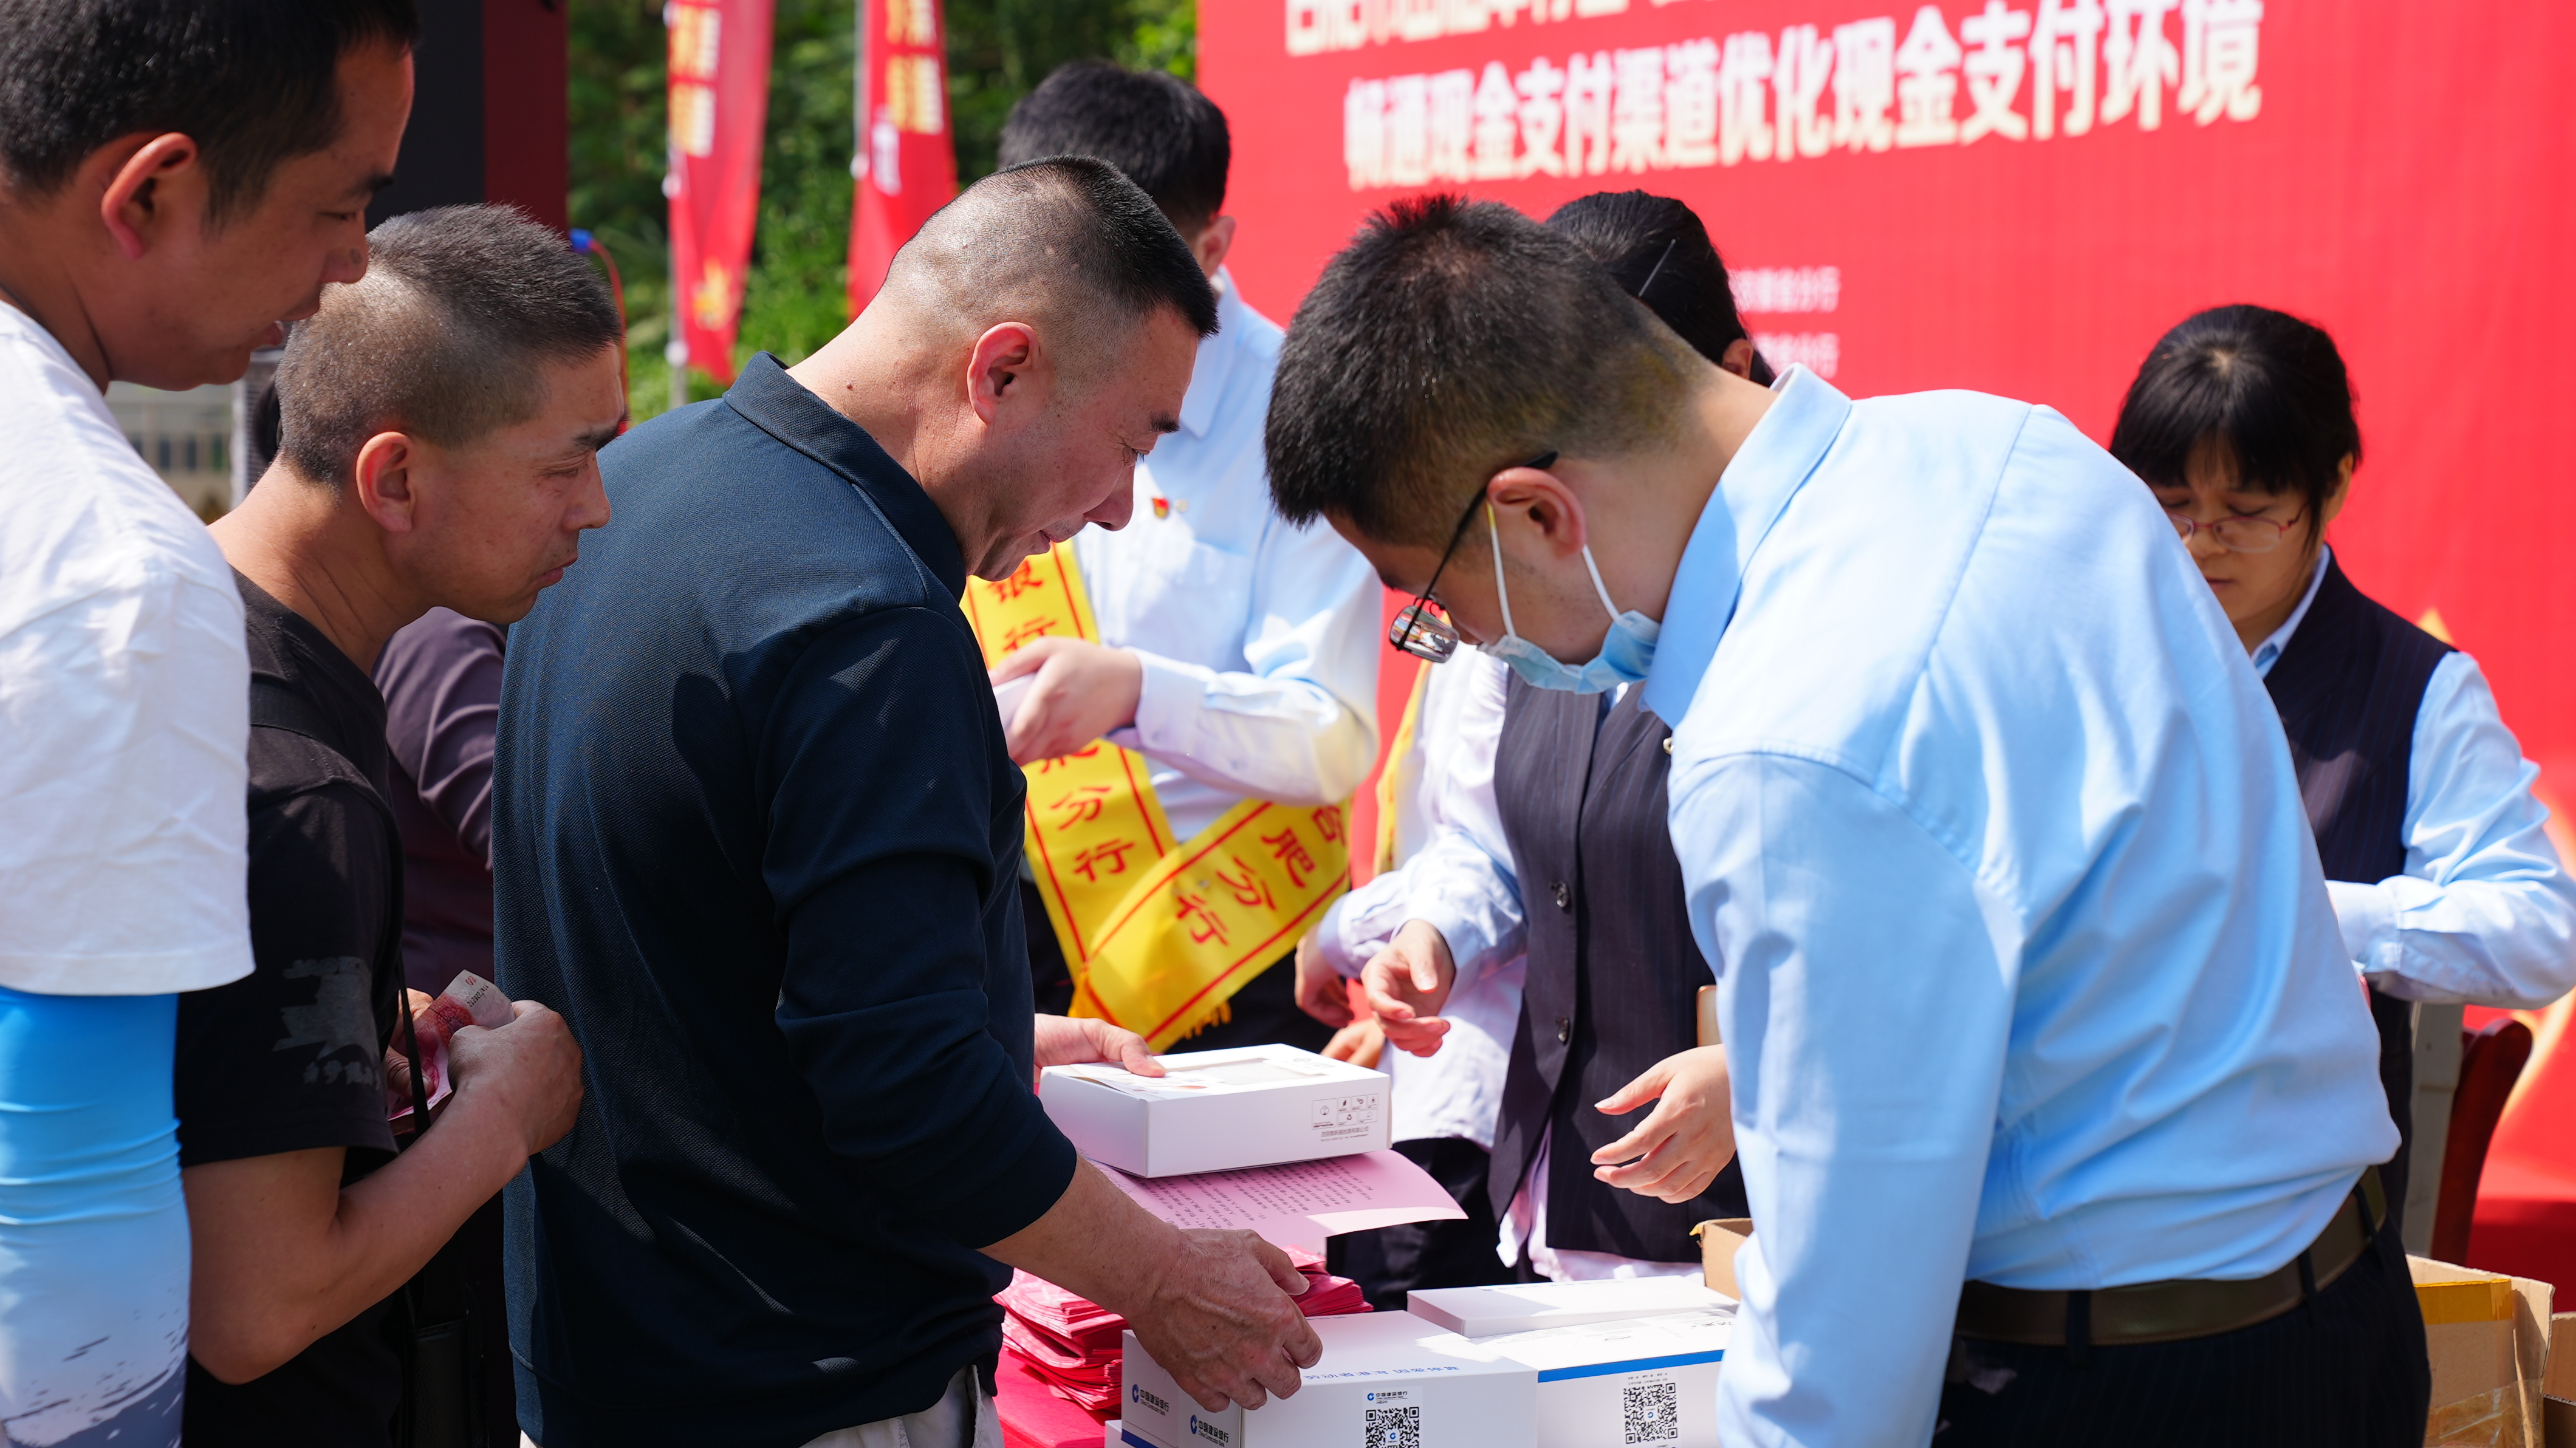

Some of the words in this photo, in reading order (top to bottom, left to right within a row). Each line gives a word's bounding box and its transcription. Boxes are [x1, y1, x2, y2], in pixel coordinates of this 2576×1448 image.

[1344, 0, 2264, 191] 畅通现金支付渠道优化现金支付环境
[1041, 745, 1136, 883] 分行
[1304, 1370, 1389, 1380] 劳动者港湾
[1393, 1365, 1461, 1374] 因爱停靠
[1140, 1390, 1170, 1412] 中国建设银行
[1199, 1421, 1229, 1443] 中国建设银行
